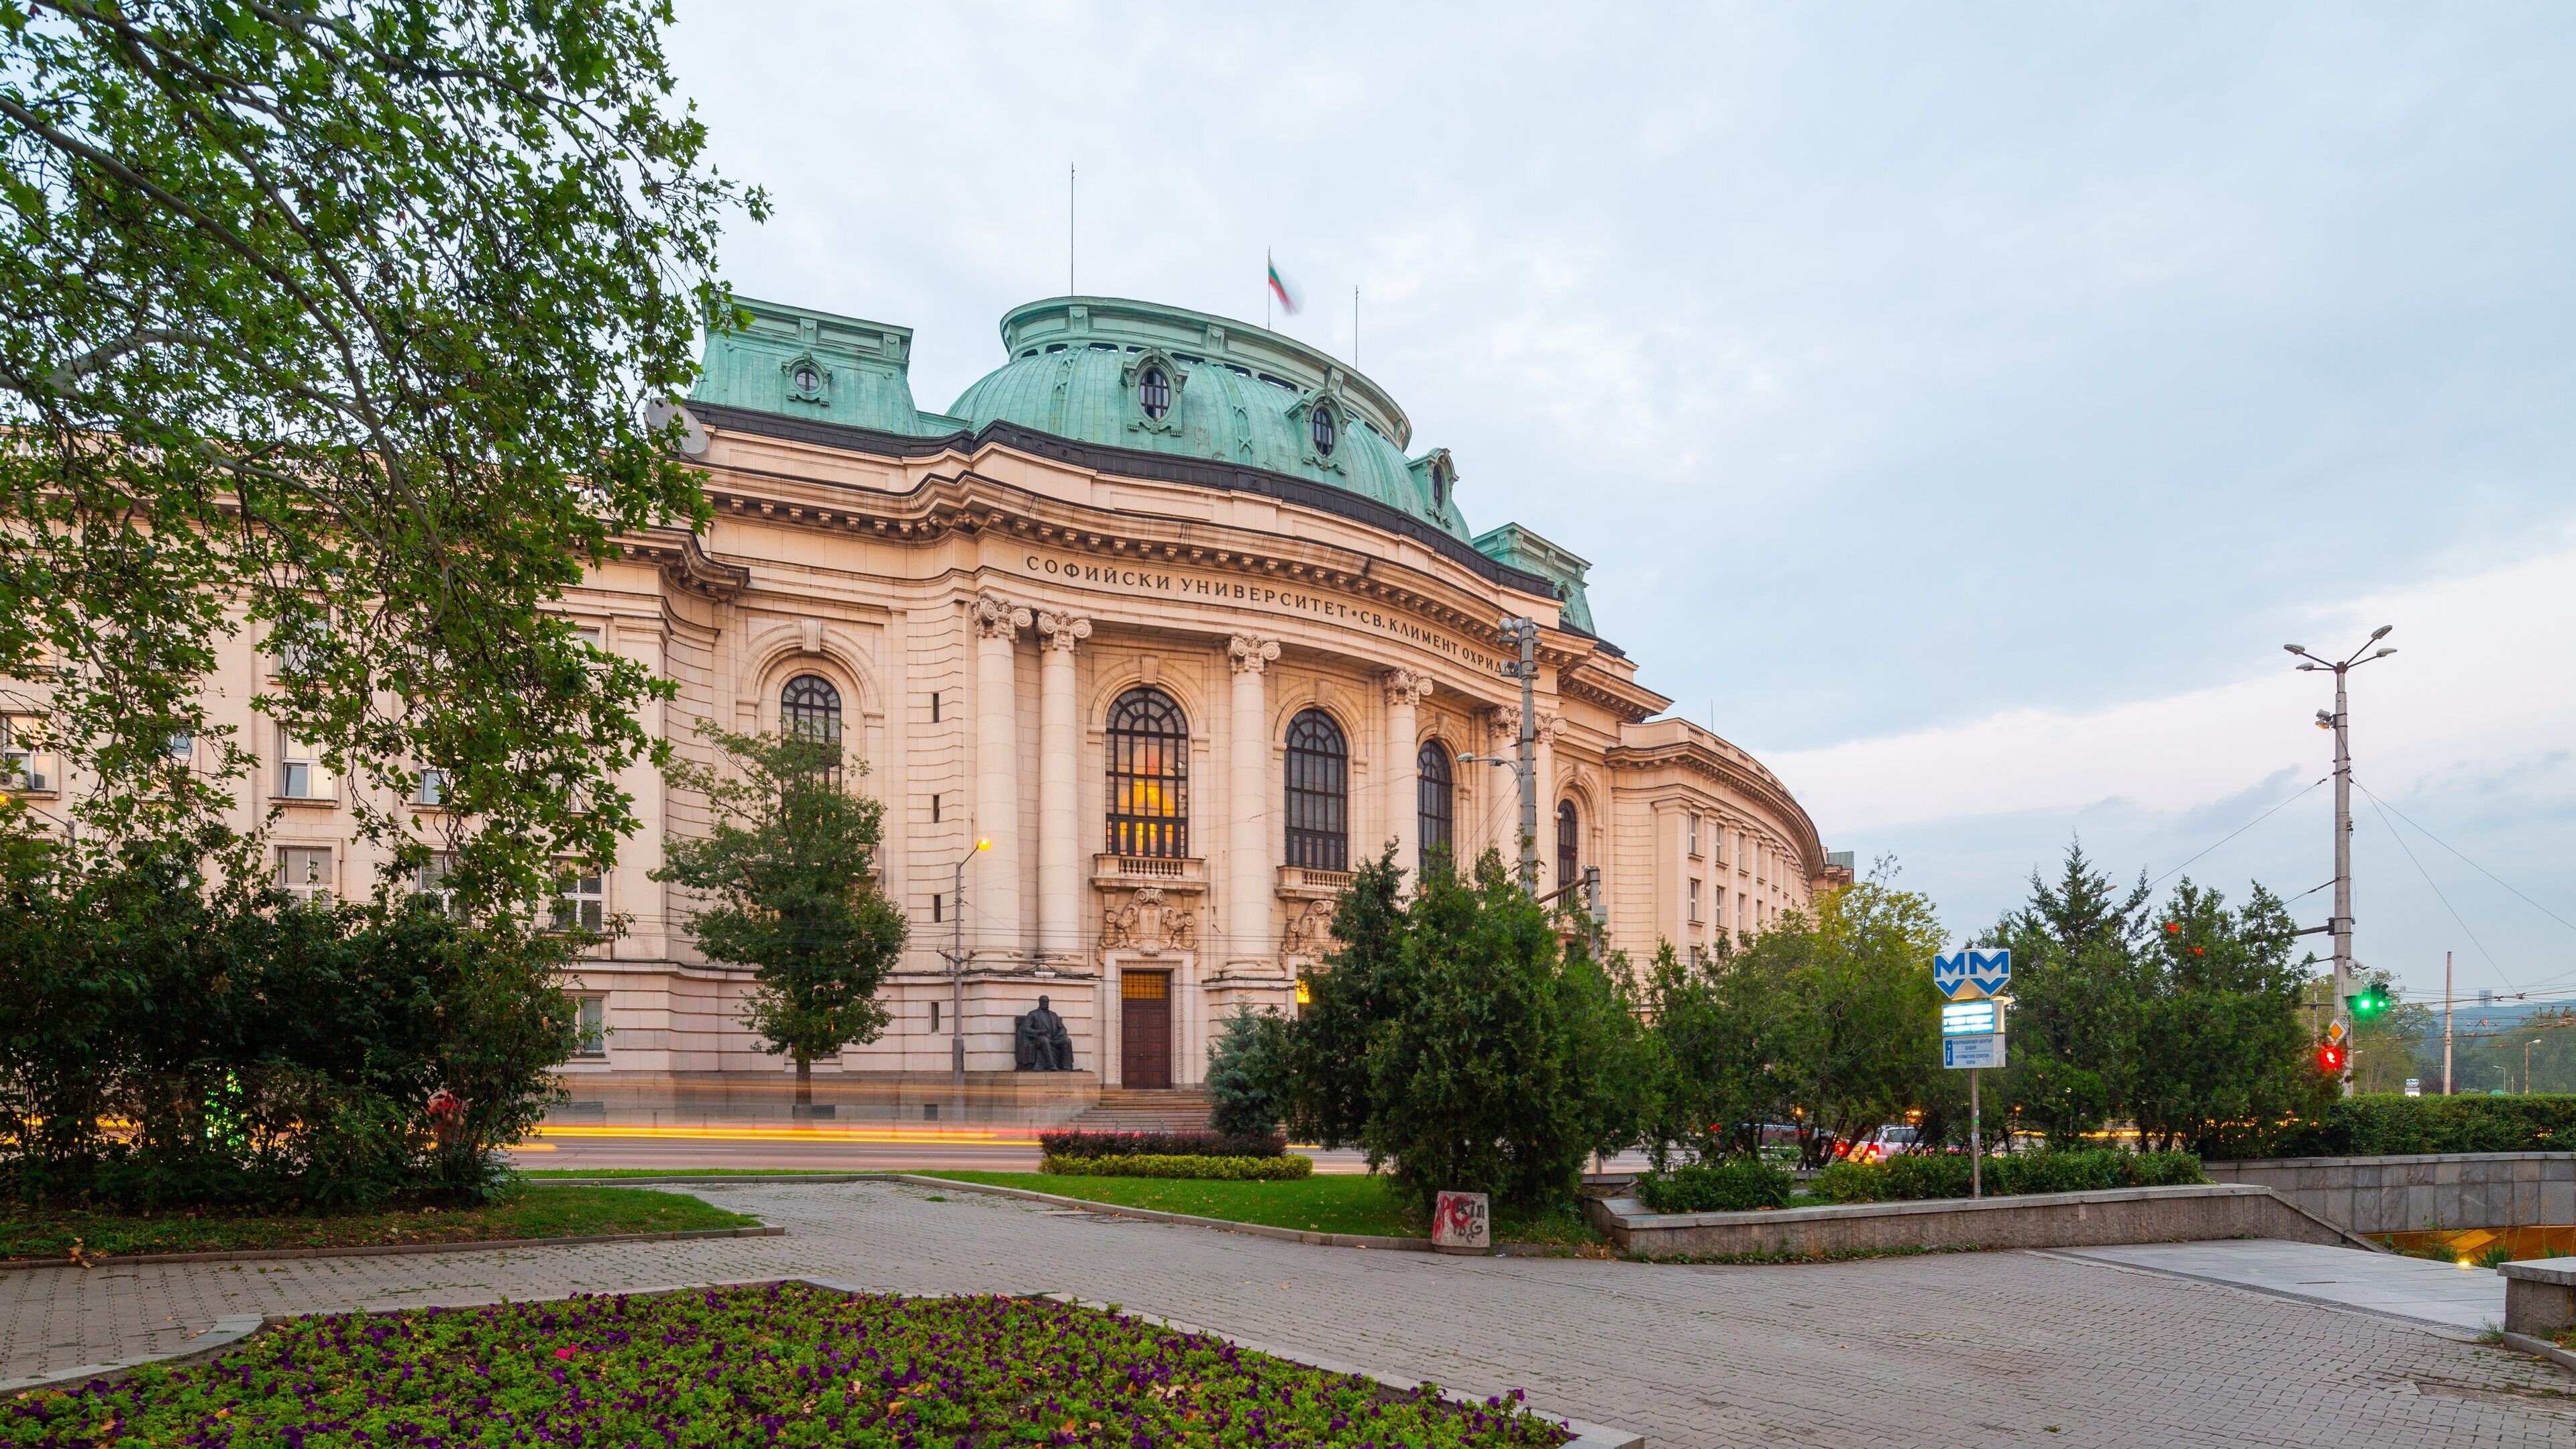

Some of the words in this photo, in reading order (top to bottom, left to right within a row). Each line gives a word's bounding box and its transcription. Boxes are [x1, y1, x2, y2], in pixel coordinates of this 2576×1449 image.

[1026, 555, 1169, 590] СОФИЙСКИ
[1180, 578, 1347, 618] УНИВЕРСИТЕТ
[1360, 610, 1385, 629] СВ.
[1389, 618, 1458, 655] КЛИМЕНТ
